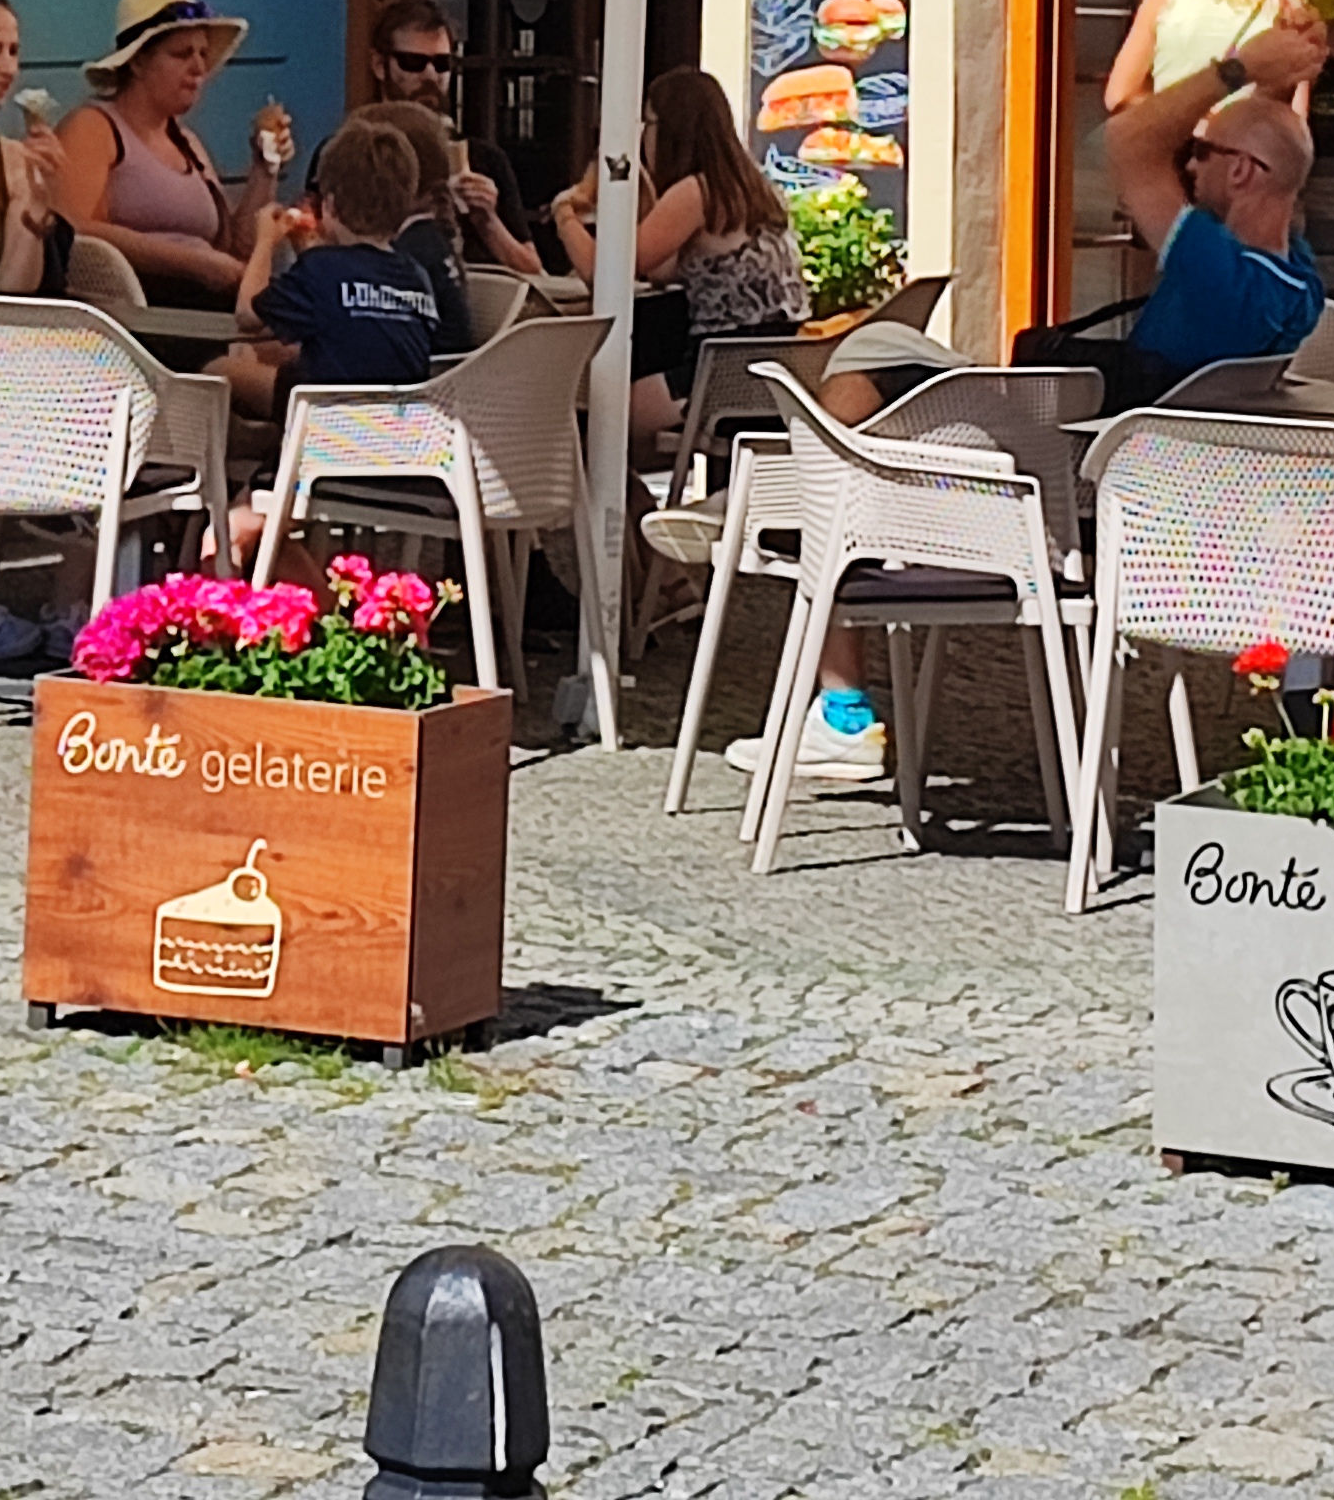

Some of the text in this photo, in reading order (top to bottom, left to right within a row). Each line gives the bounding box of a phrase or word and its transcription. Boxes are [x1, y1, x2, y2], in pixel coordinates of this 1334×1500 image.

[58, 711, 388, 798] Bonté gelaterie
[1184, 841, 1327, 911] Bonté
